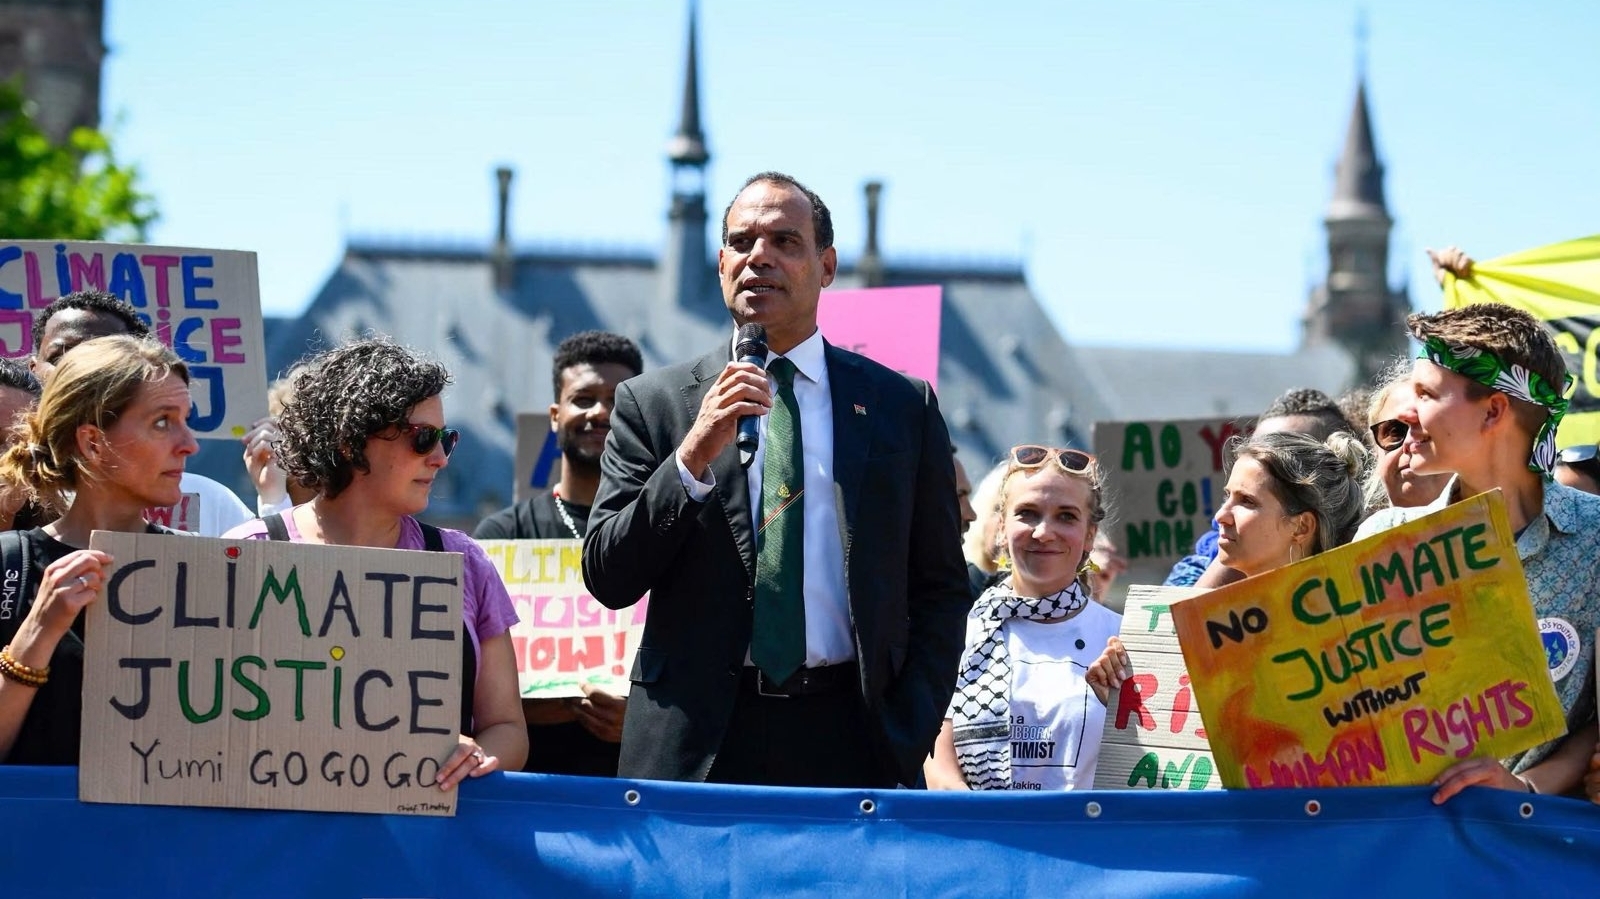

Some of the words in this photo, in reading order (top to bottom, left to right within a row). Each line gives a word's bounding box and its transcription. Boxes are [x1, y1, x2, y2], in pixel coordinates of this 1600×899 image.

[1157, 476, 1214, 518] GO!
[1206, 606, 1269, 650] NO
[1291, 523, 1501, 626] CLIMATE
[1272, 602, 1455, 702] JUSTICE
[1323, 671, 1427, 729] WITHOUT
[130, 739, 223, 785] Yumi
